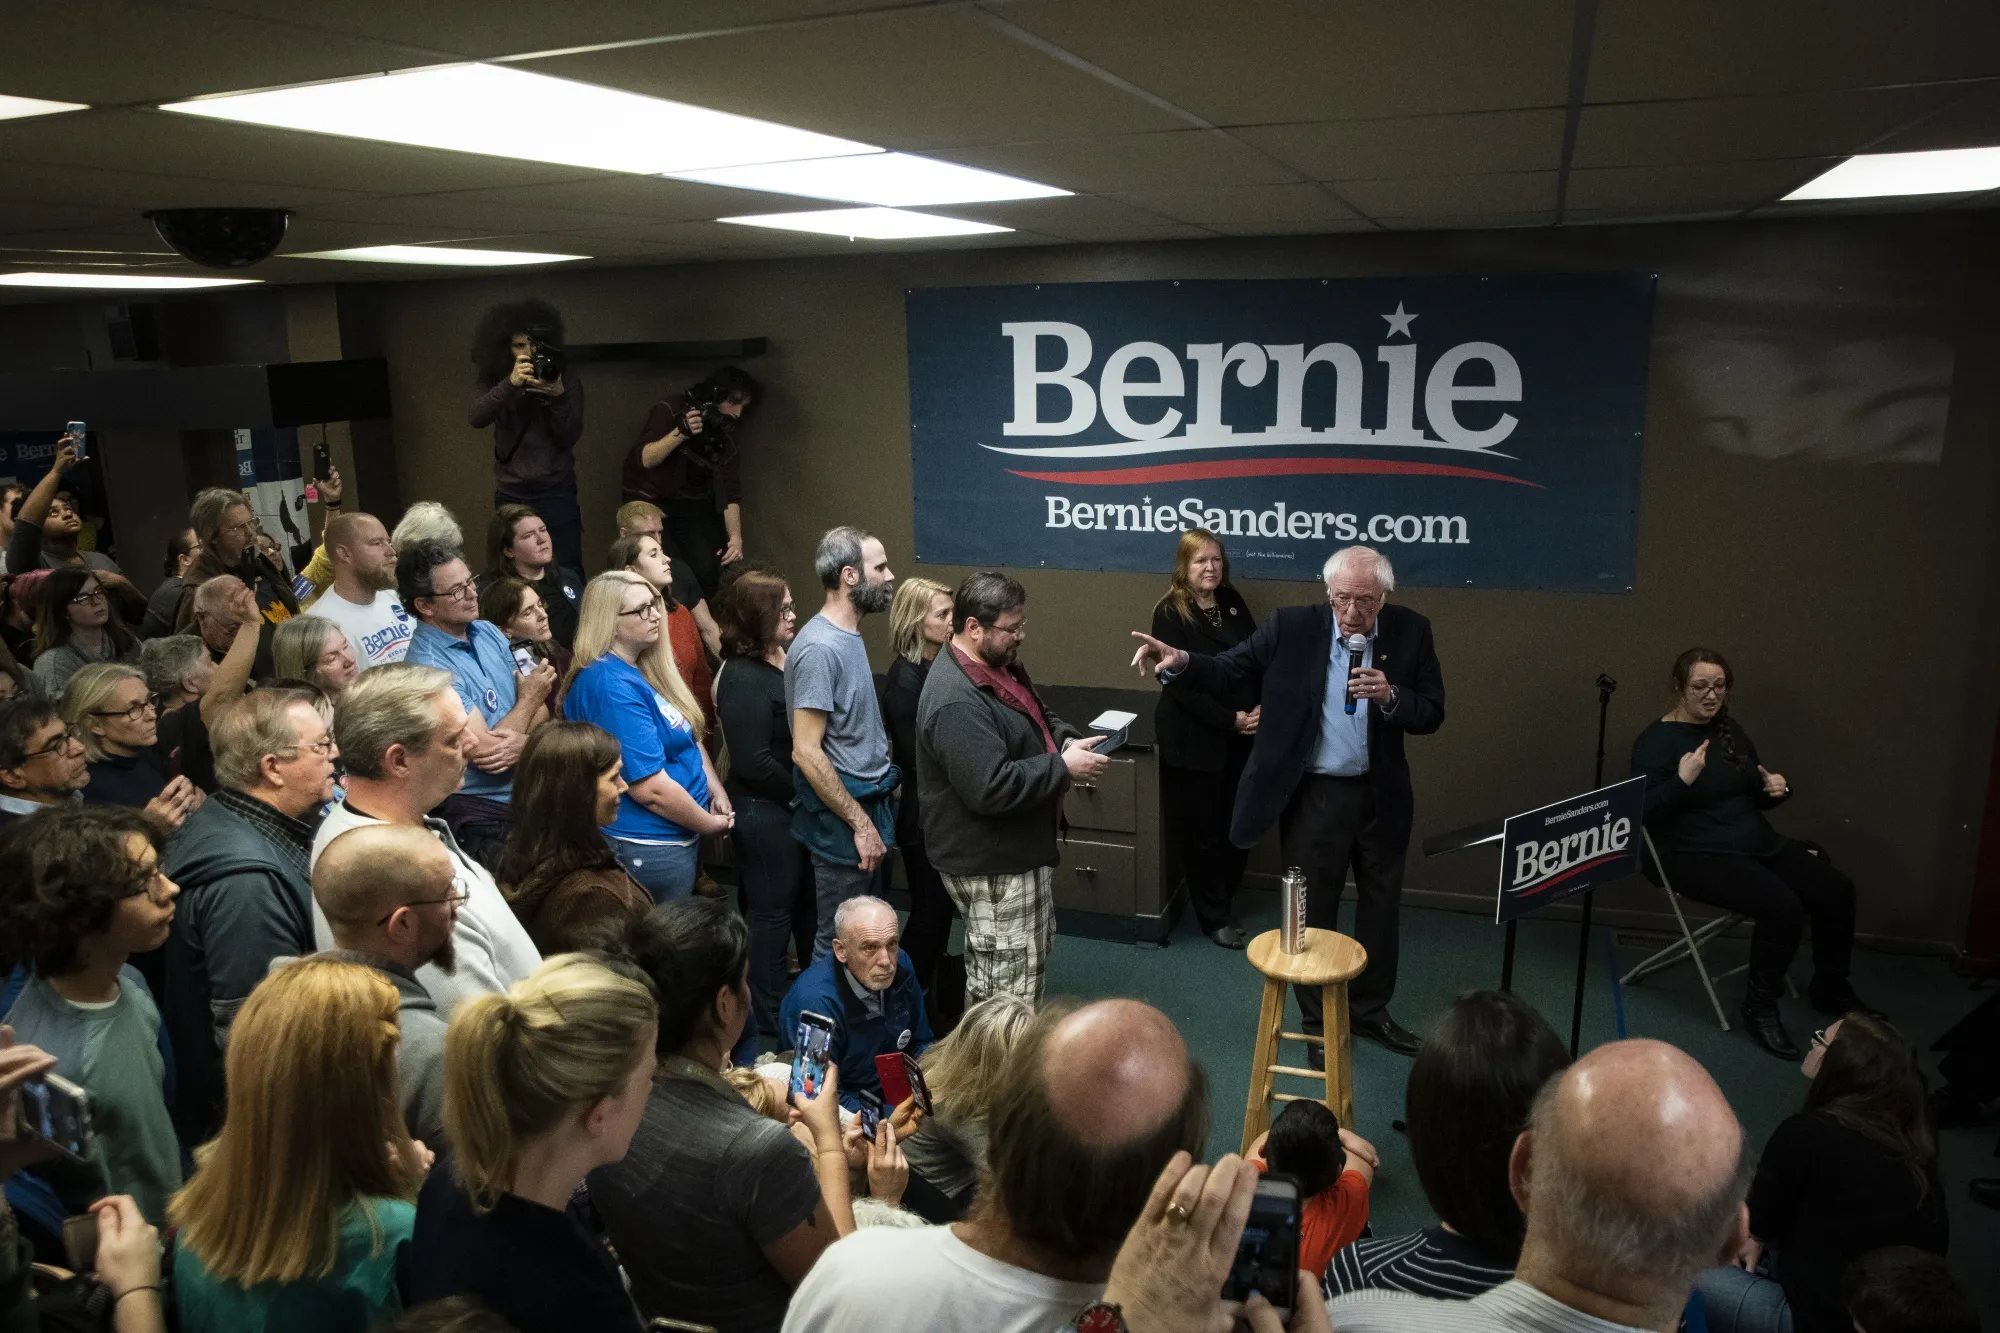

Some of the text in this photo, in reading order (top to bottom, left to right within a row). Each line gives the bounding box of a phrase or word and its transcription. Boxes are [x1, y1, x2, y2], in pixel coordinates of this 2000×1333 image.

[1001, 301, 1523, 450] Bernie
[1045, 495, 1470, 544] BernieSanders.com
[361, 621, 411, 655] Bernie
[1544, 800, 1609, 826] BernieSanders.com
[1512, 810, 1631, 886] Bernie
